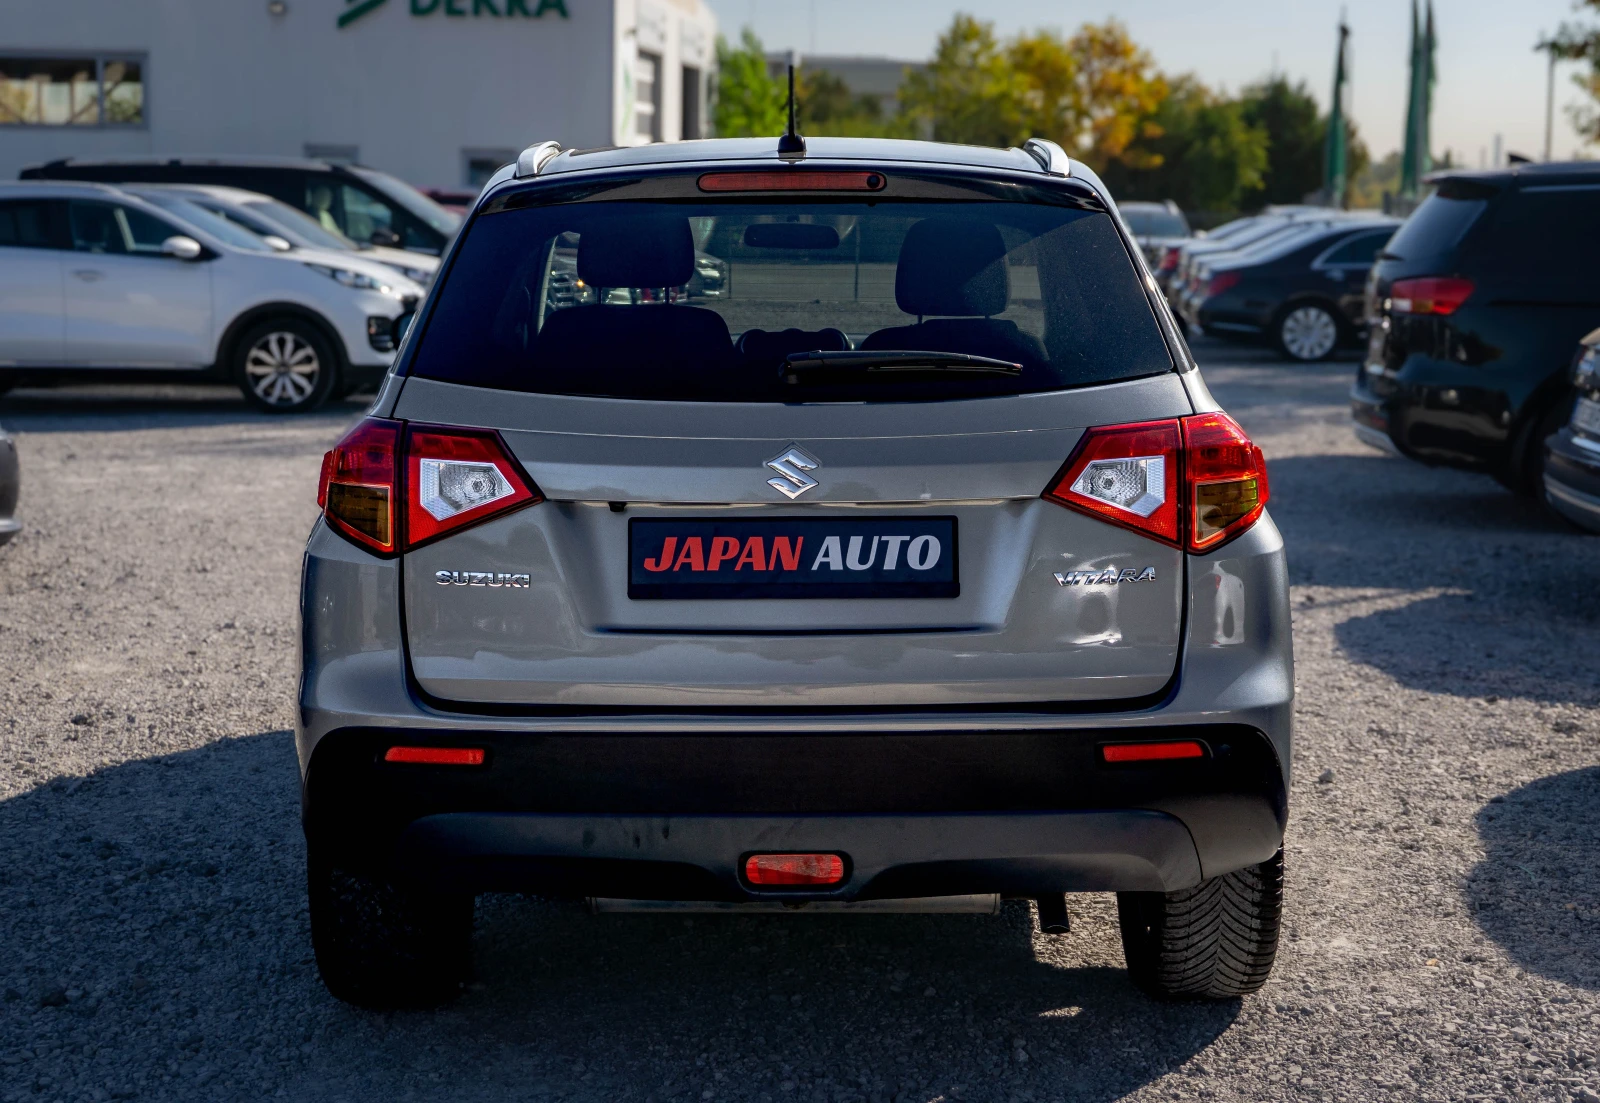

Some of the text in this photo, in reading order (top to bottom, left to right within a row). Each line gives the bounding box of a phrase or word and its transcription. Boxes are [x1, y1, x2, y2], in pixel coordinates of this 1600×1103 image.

[643, 535, 942, 572] JAPAN AUTO
[435, 570, 531, 589] SUZUKI
[1053, 566, 1157, 587] VITARA
